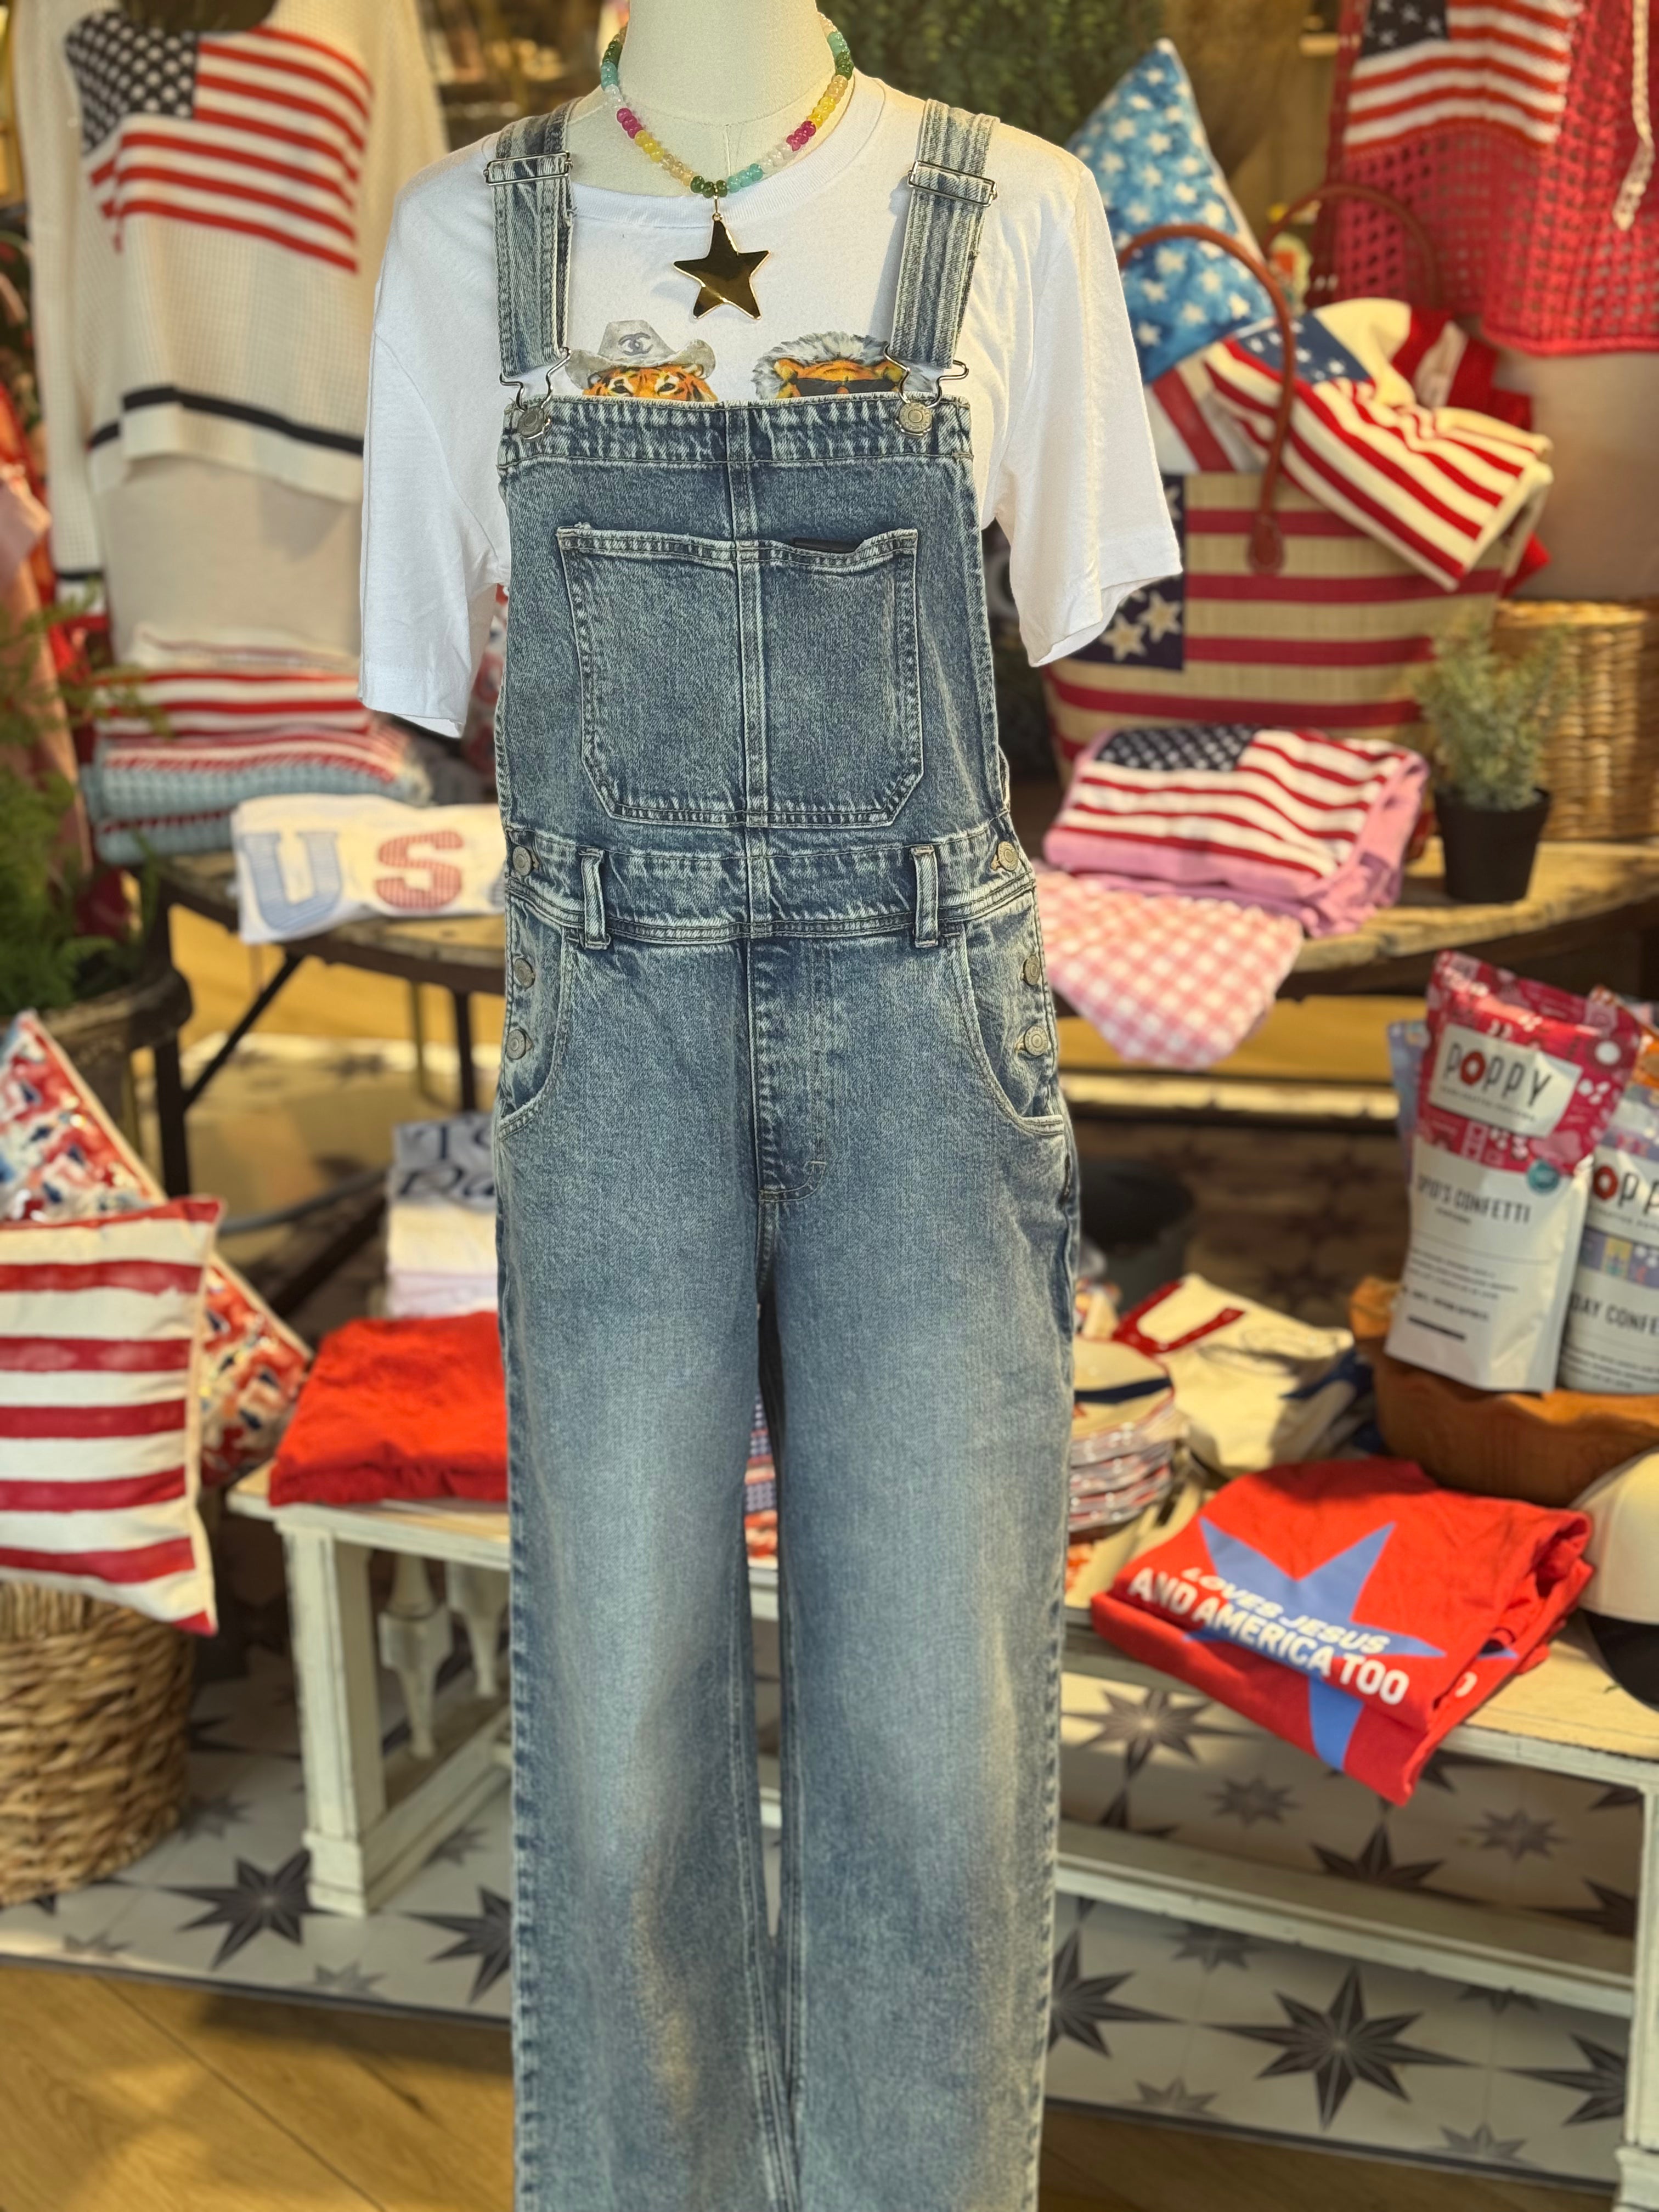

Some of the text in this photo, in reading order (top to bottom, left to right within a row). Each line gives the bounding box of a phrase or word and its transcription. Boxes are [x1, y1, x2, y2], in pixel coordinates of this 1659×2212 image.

[1443, 1041, 1552, 1108] POPPY
[1455, 1188, 1531, 1225] CONFETTI
[1126, 1566, 1199, 1616] AND
[1192, 1596, 1335, 1678] AMERICA
[1339, 1652, 1410, 1706] TOO
[1181, 1566, 1391, 1655] LOVES JESUS
